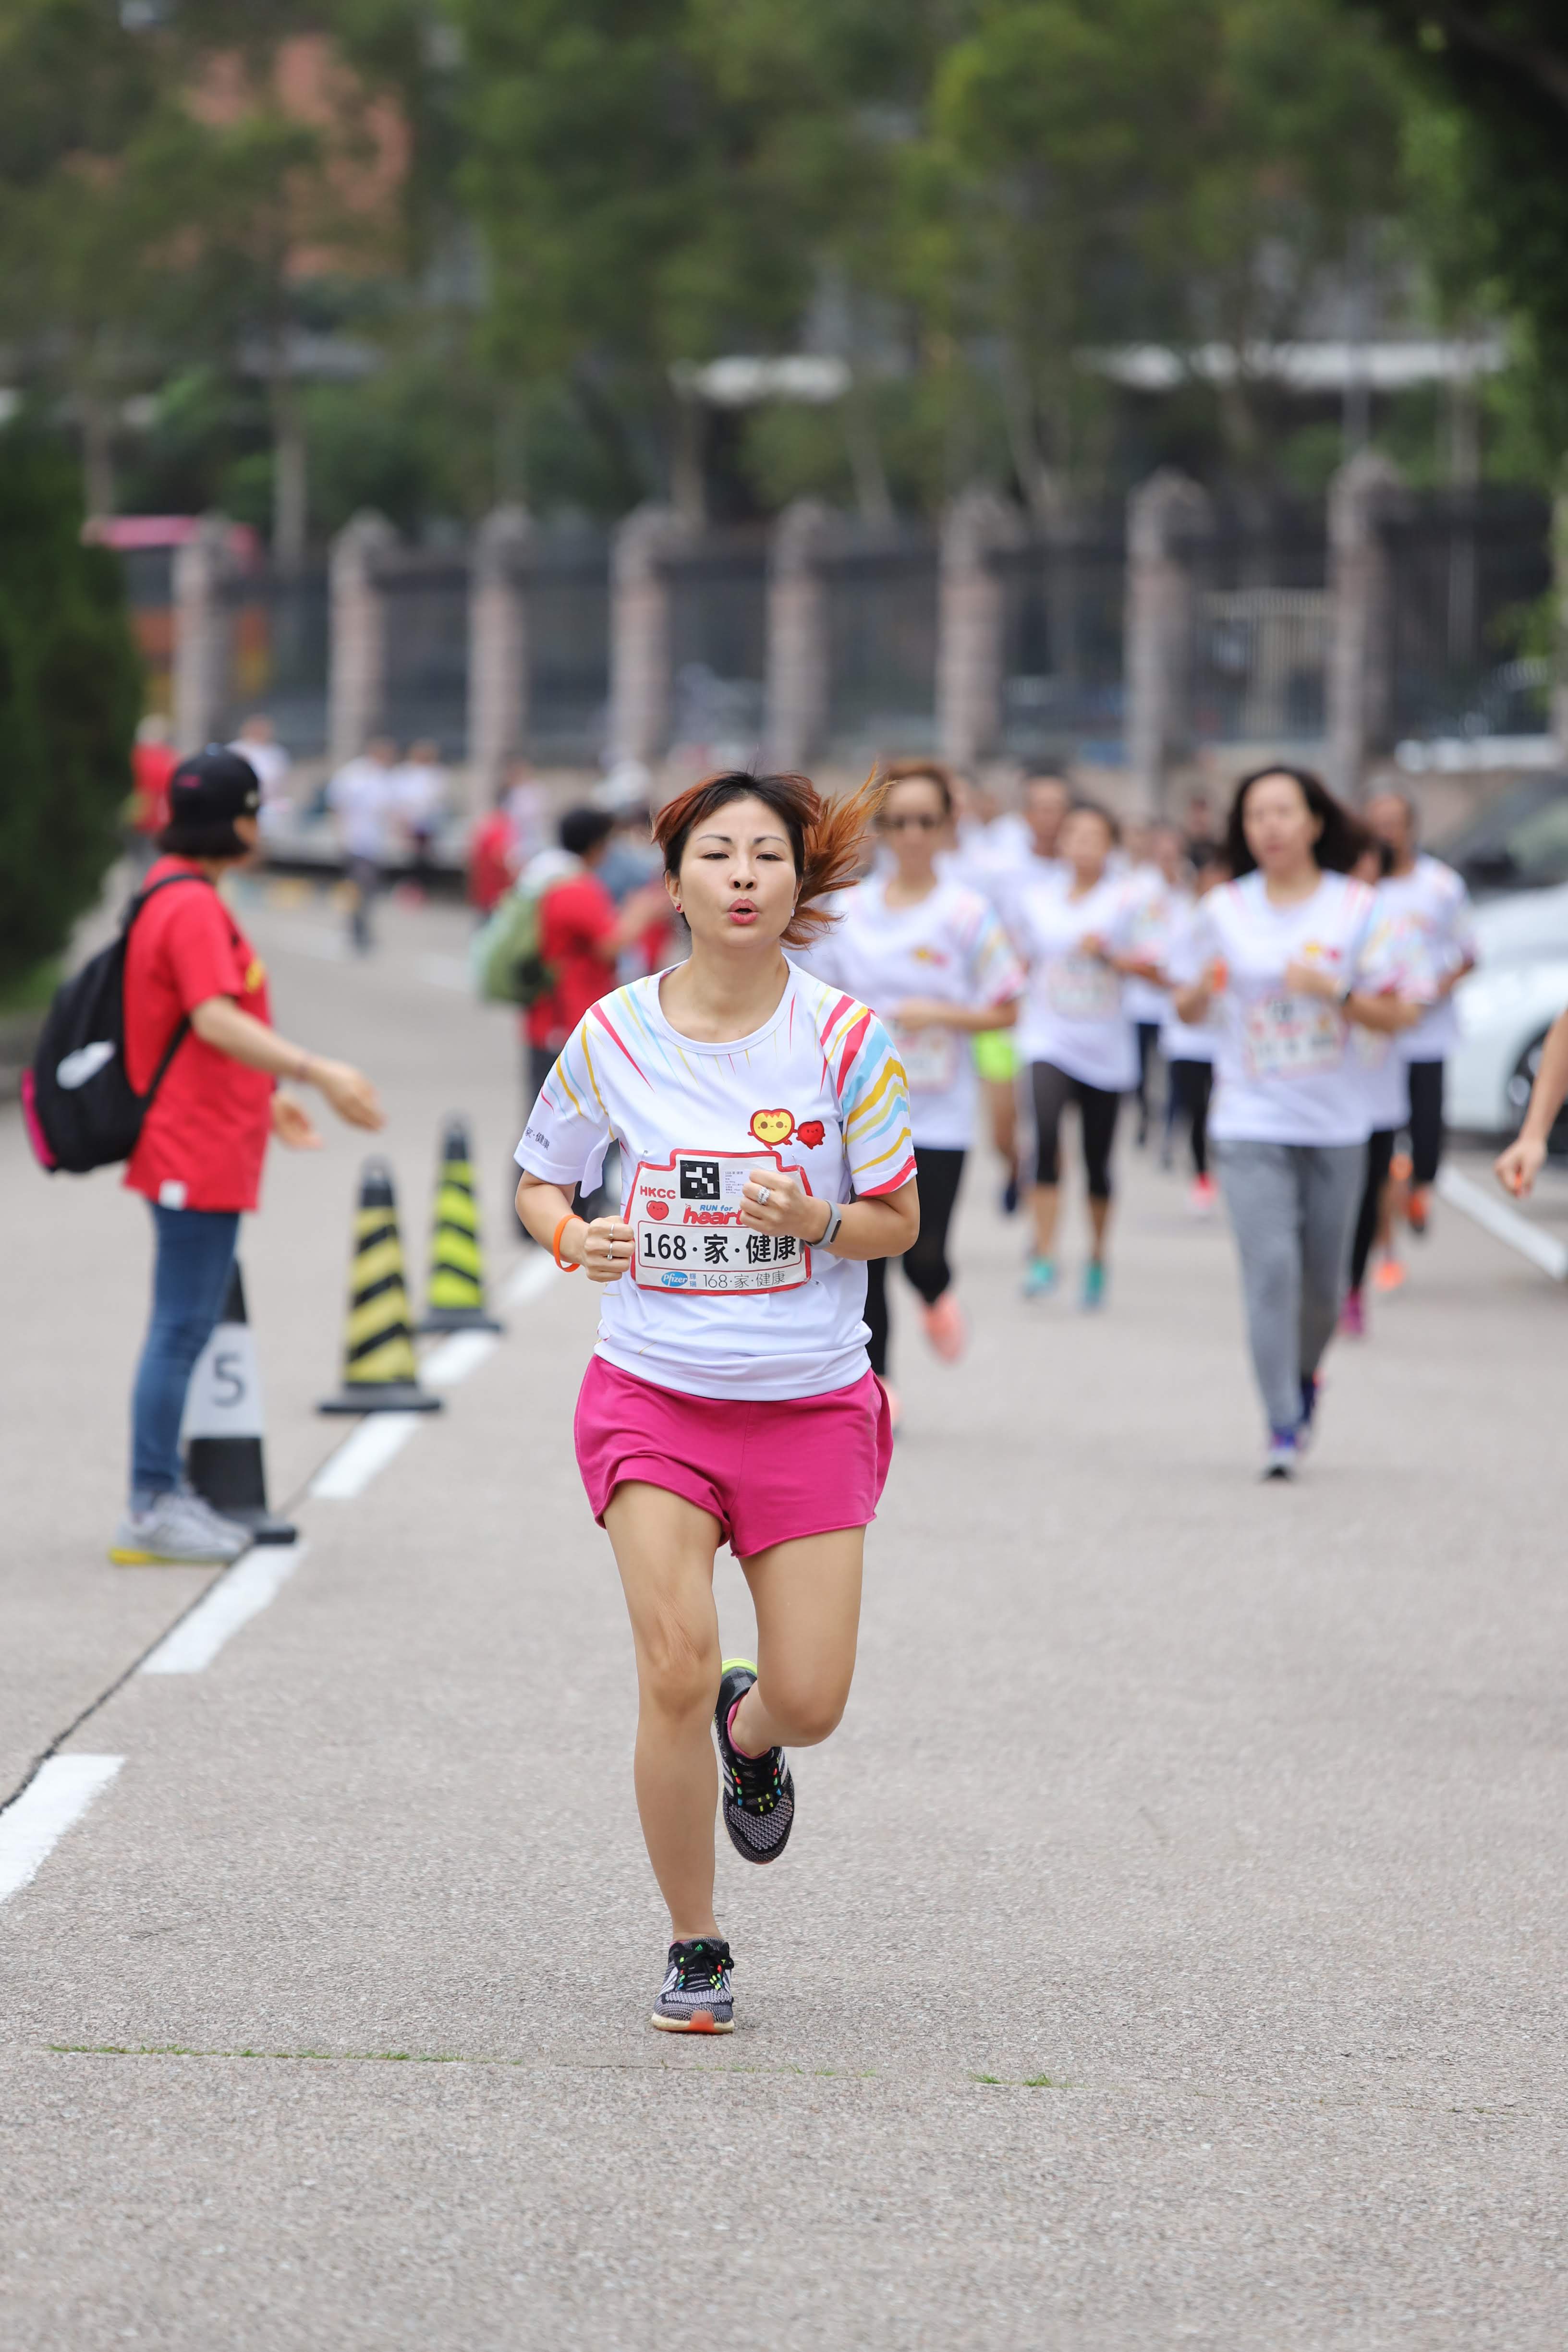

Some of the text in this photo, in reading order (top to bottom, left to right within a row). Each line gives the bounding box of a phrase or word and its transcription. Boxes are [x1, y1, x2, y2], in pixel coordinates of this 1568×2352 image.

[640, 1185, 676, 1199] HKCC
[663, 1273, 687, 1286] Pfizer
[690, 1273, 696, 1287] 輝瑞
[213, 1352, 246, 1408] 5
